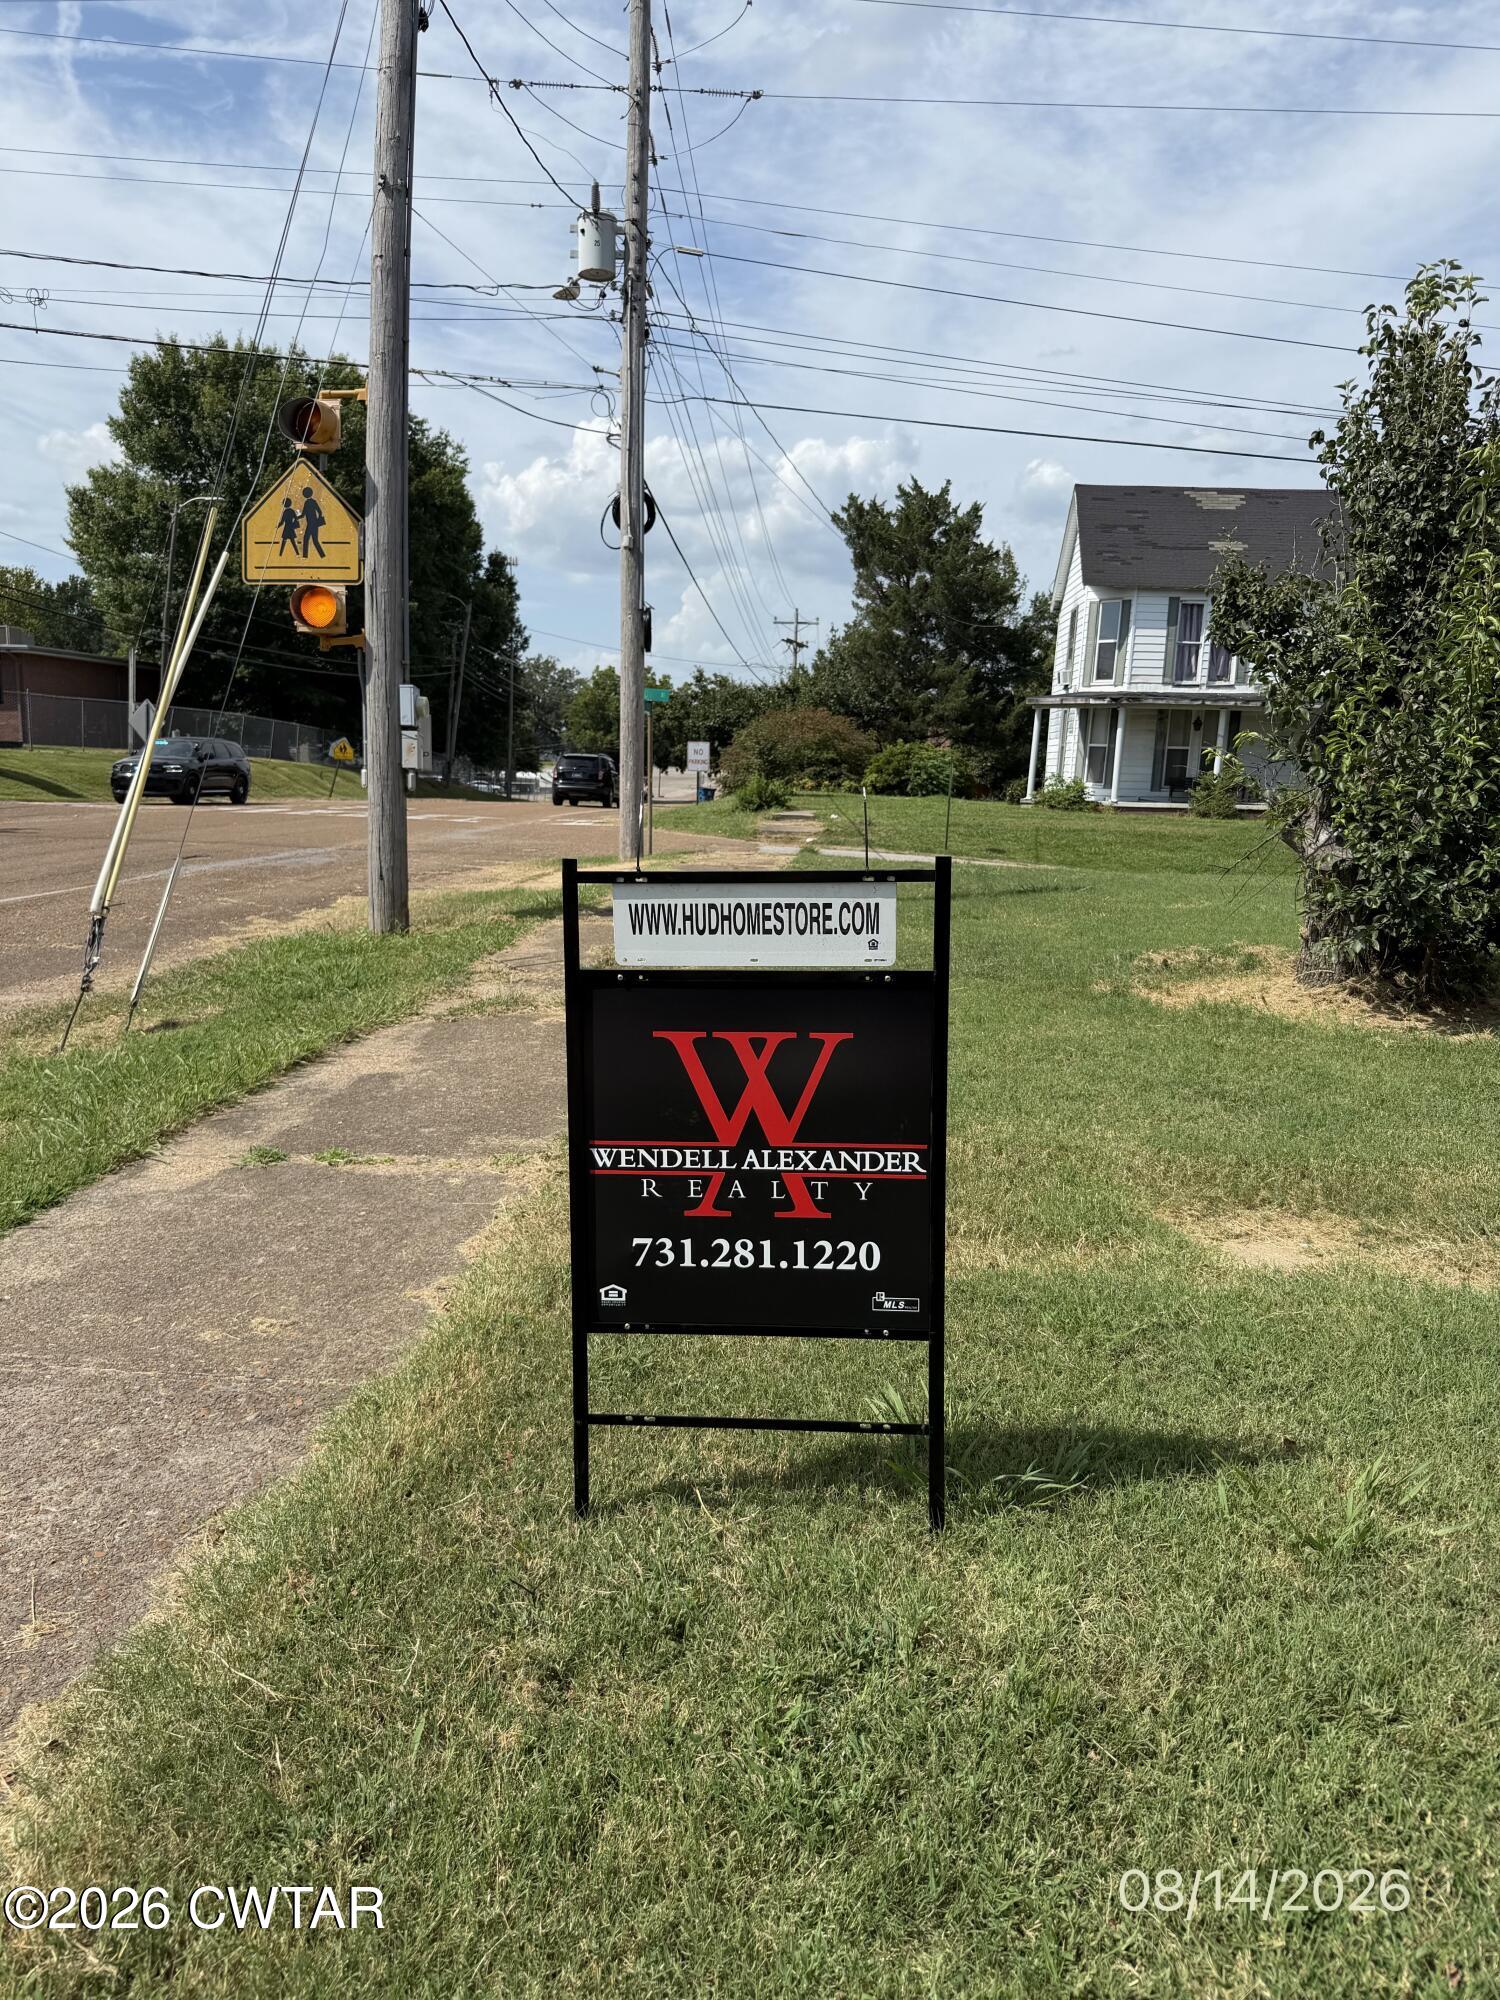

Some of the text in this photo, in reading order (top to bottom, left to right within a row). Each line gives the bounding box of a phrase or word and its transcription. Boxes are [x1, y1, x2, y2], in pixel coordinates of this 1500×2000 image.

[693, 748, 704, 756] NO
[629, 902, 880, 935] WWW.HUDHOMESTORE.COM
[590, 1148, 927, 1172] WENDELL ALEXANDER
[641, 1178, 873, 1200] REALTY
[632, 1237, 881, 1271] 731.281.1220
[883, 1300, 905, 1309] MLS
